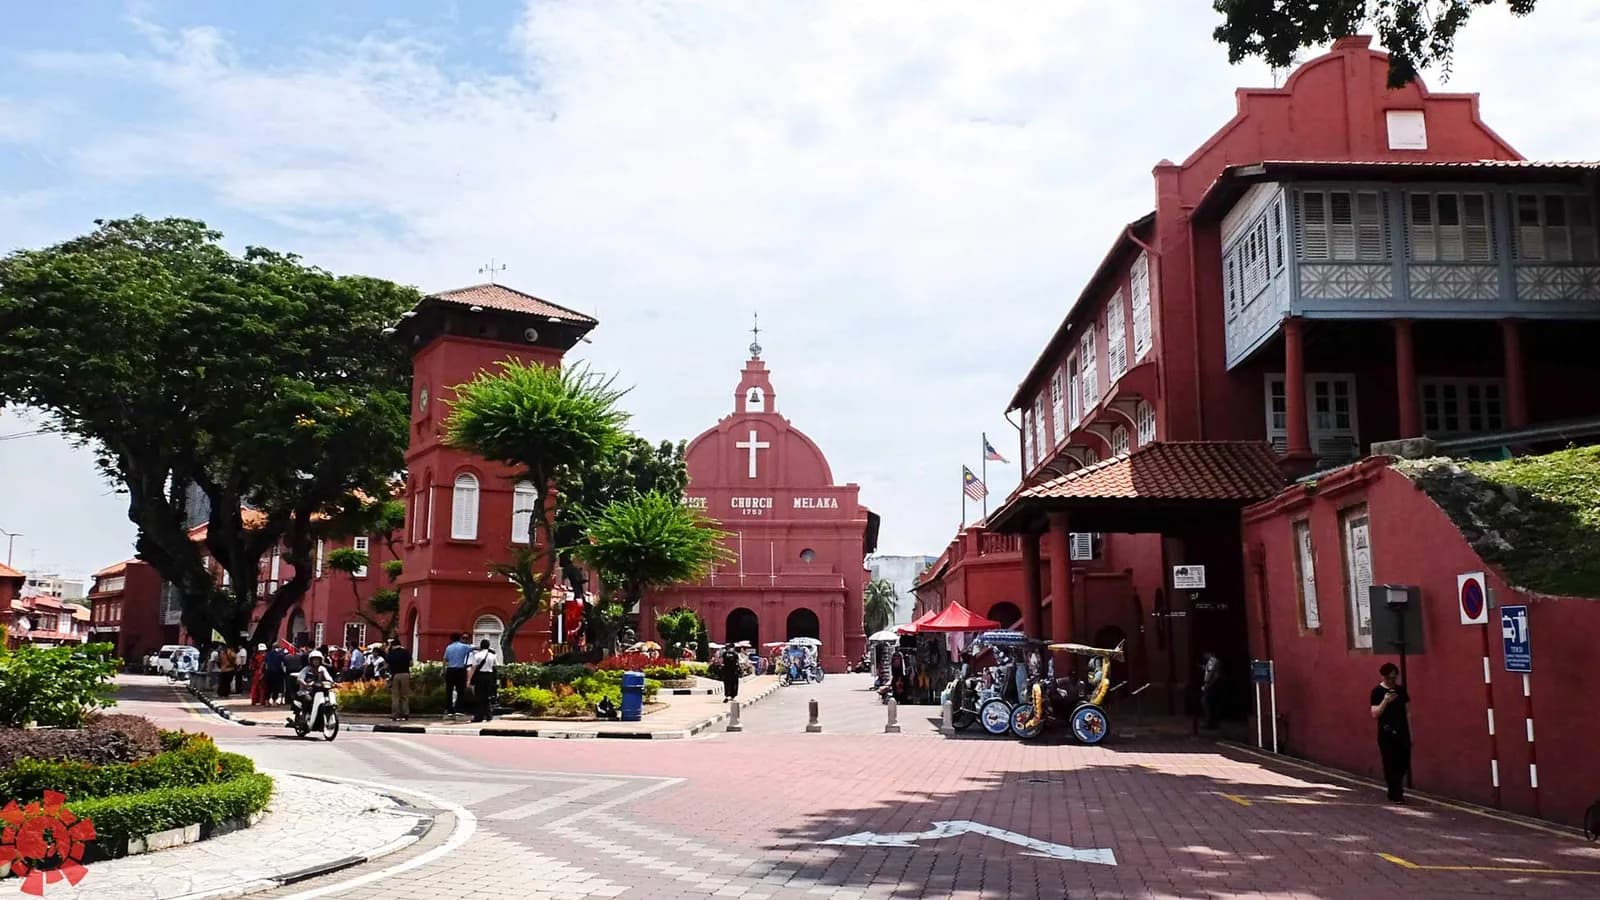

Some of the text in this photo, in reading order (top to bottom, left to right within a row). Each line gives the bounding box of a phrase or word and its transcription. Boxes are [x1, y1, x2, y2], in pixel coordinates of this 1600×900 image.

[680, 497, 838, 509] RIST CHURCH MELAKA
